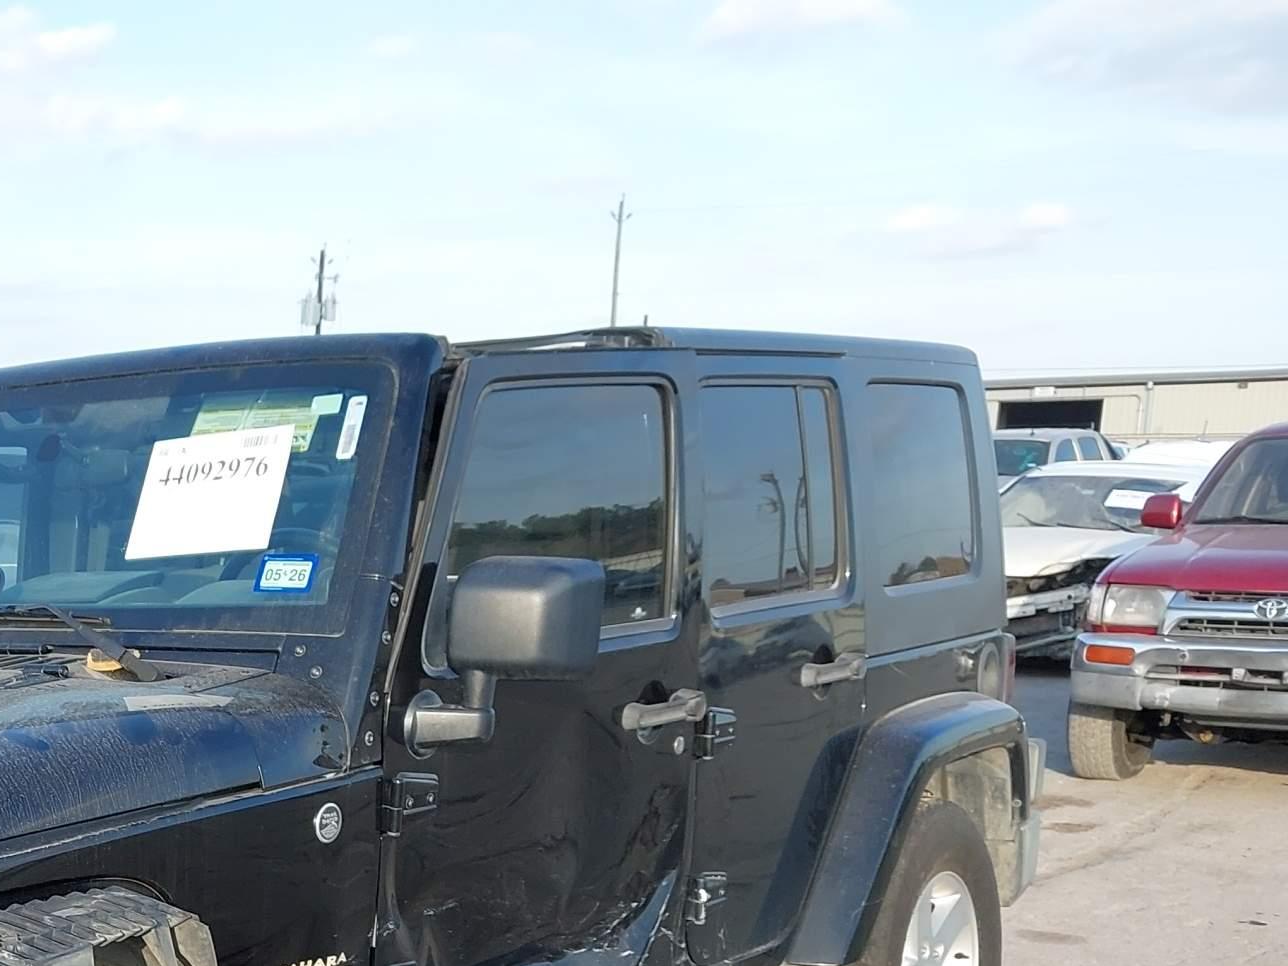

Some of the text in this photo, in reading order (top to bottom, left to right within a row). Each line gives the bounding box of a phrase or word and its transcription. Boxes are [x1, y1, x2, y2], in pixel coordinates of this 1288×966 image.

[159, 456, 268, 485] 44092976
[264, 568, 307, 581] 05 26
